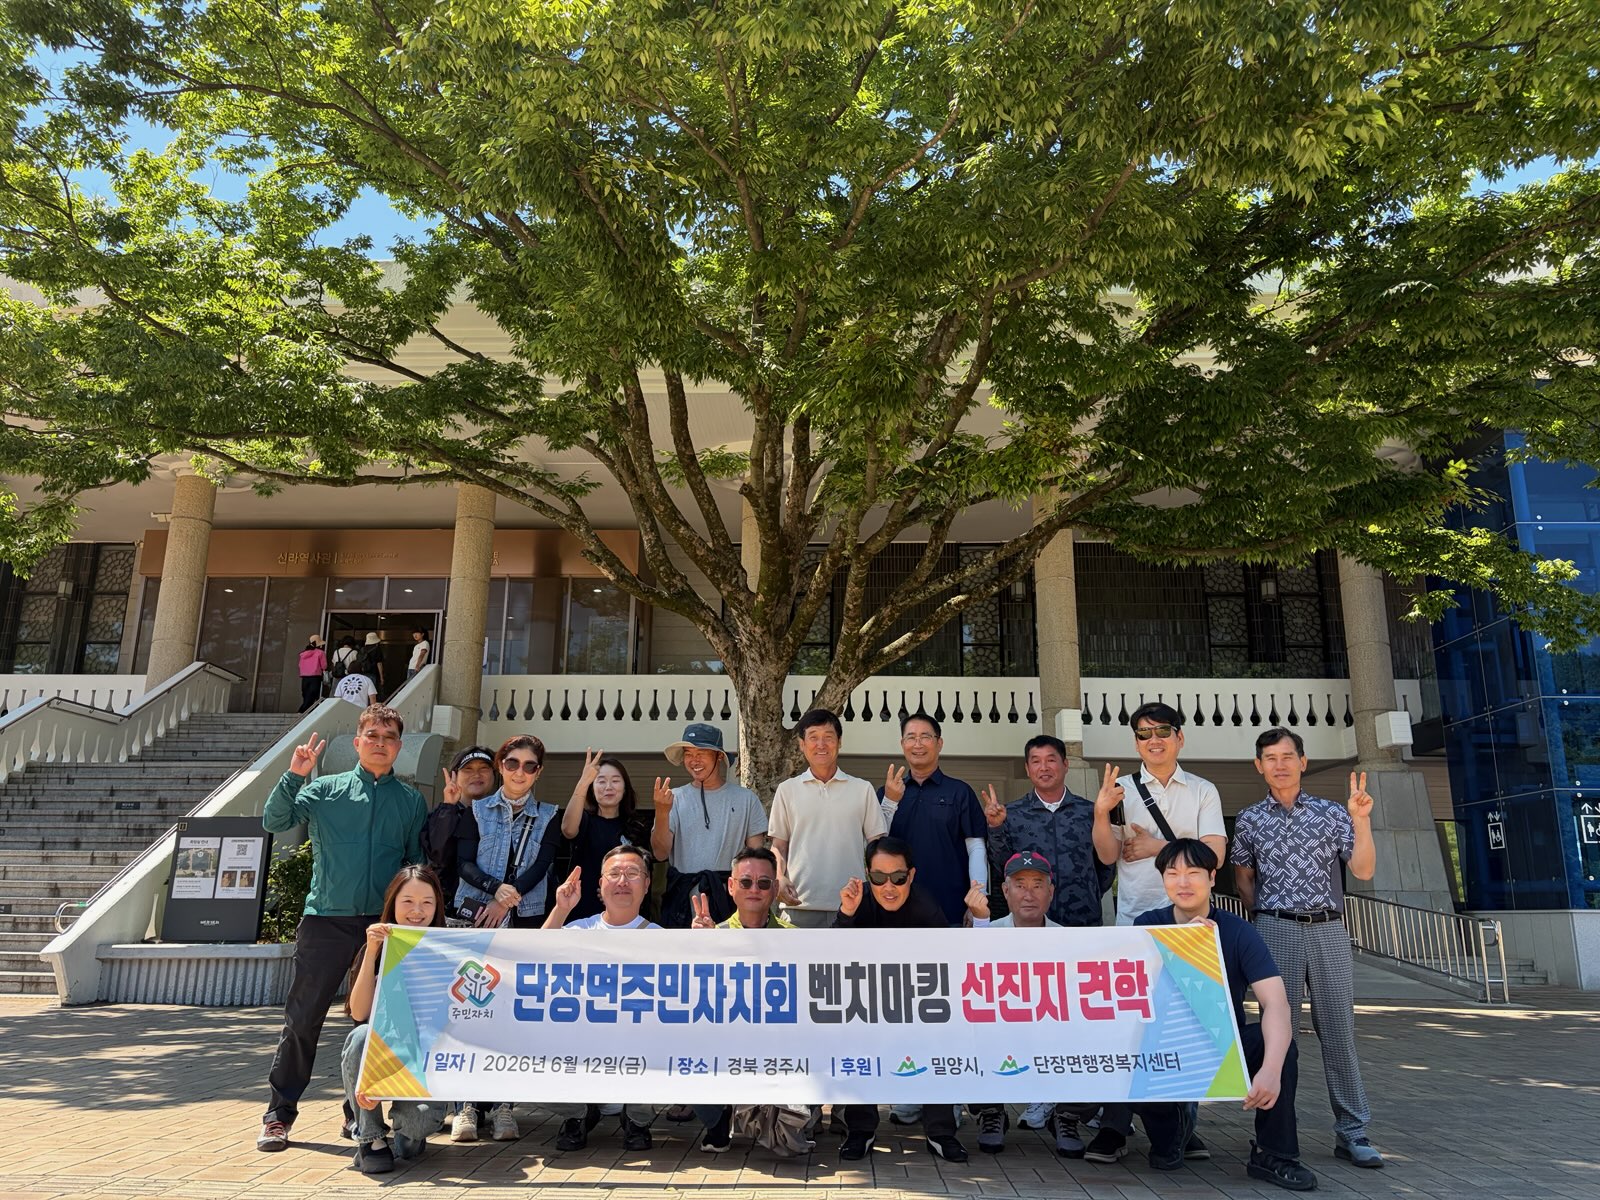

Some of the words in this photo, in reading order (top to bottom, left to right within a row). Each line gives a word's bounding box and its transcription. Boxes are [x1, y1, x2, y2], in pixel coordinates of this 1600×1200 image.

[278, 551, 331, 565] 신라역사관
[513, 961, 798, 1024] 단장면주민자치회
[808, 961, 952, 1024] 벤치마킹
[961, 961, 1070, 1023] 선진지
[1077, 958, 1152, 1021] 견학
[452, 1007, 494, 1019] 주민자치
[434, 1052, 466, 1072] 일자
[483, 1054, 546, 1074] 2026년
[551, 1055, 578, 1075] 6월
[583, 1055, 648, 1076] 12일(금)
[677, 1057, 709, 1075] 장소
[727, 1057, 758, 1076] 경북
[763, 1057, 809, 1076] 경주시
[840, 1057, 872, 1077] 후원
[931, 1056, 984, 1077] 밀양시,
[1033, 1051, 1182, 1074] 단장면행정복지센터
